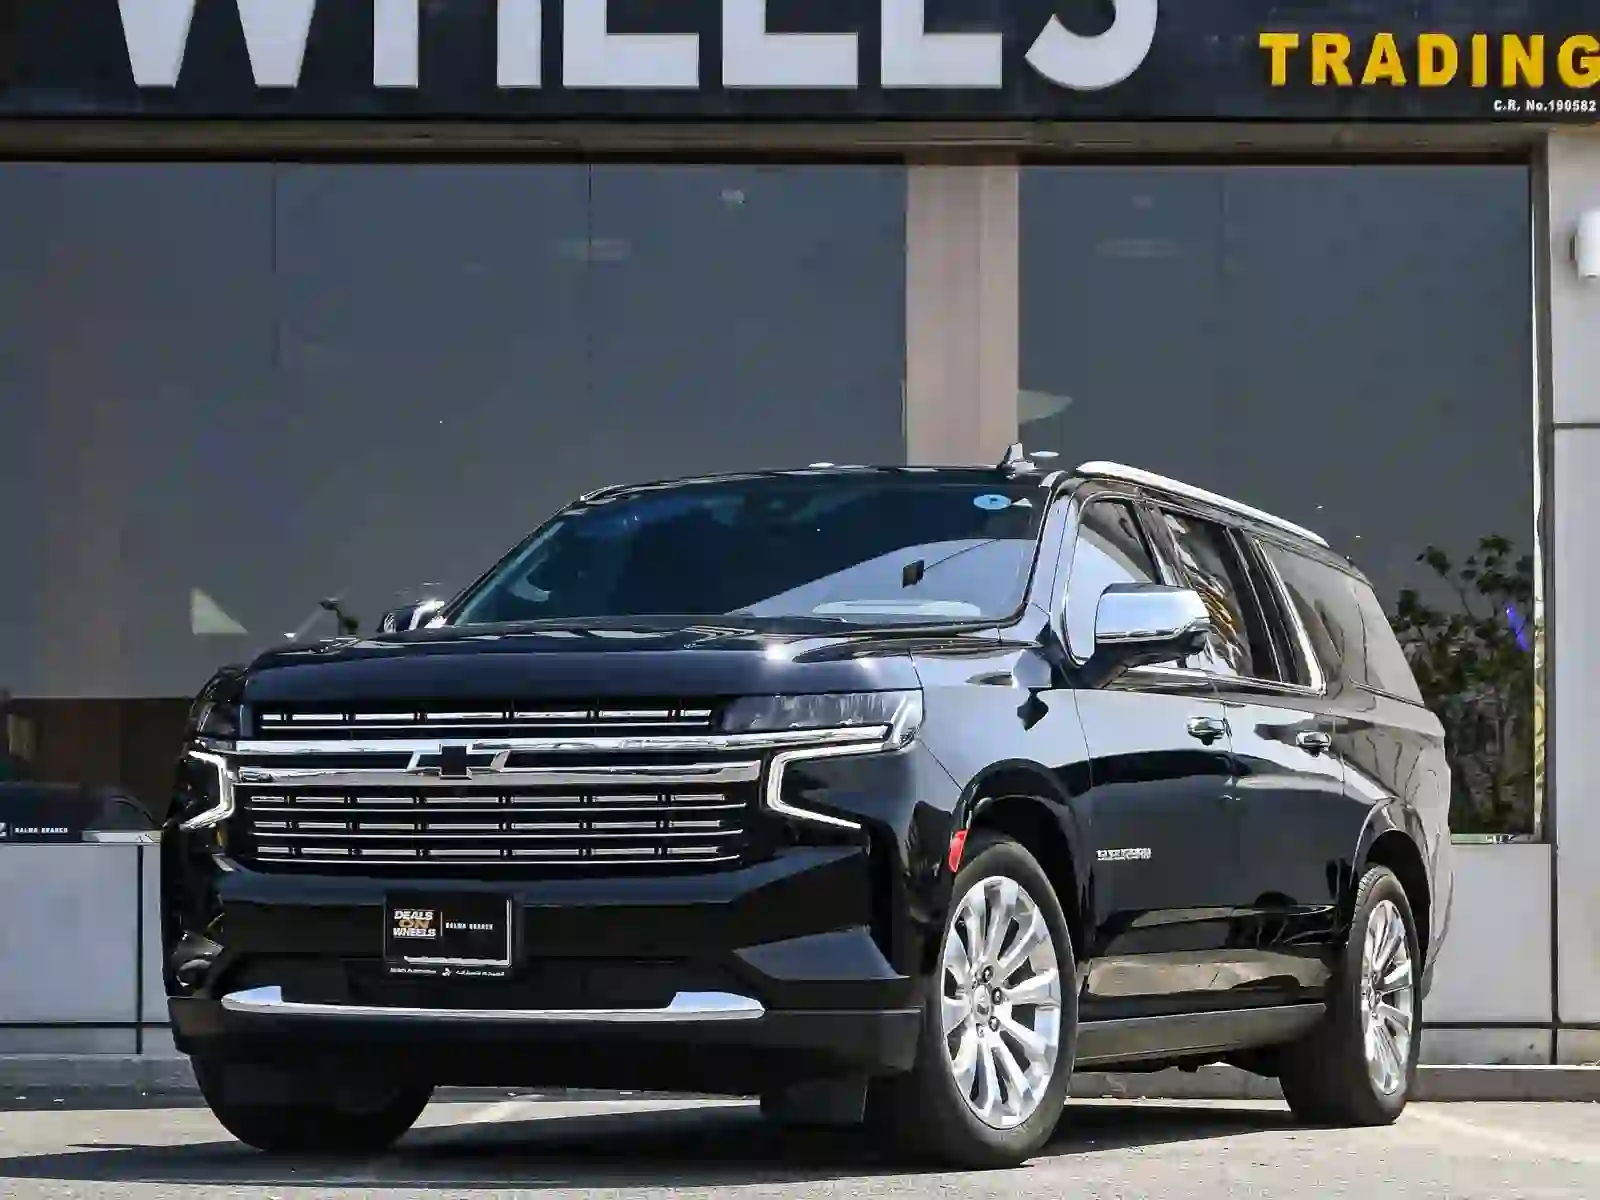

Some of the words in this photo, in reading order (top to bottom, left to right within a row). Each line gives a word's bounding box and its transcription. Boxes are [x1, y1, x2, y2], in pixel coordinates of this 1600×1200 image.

[1260, 33, 1600, 88] TRADING
[1493, 99, 1521, 112] C.R.
[394, 910, 434, 920] DEALS
[398, 919, 430, 929] ON
[392, 927, 437, 937] WHEELS
